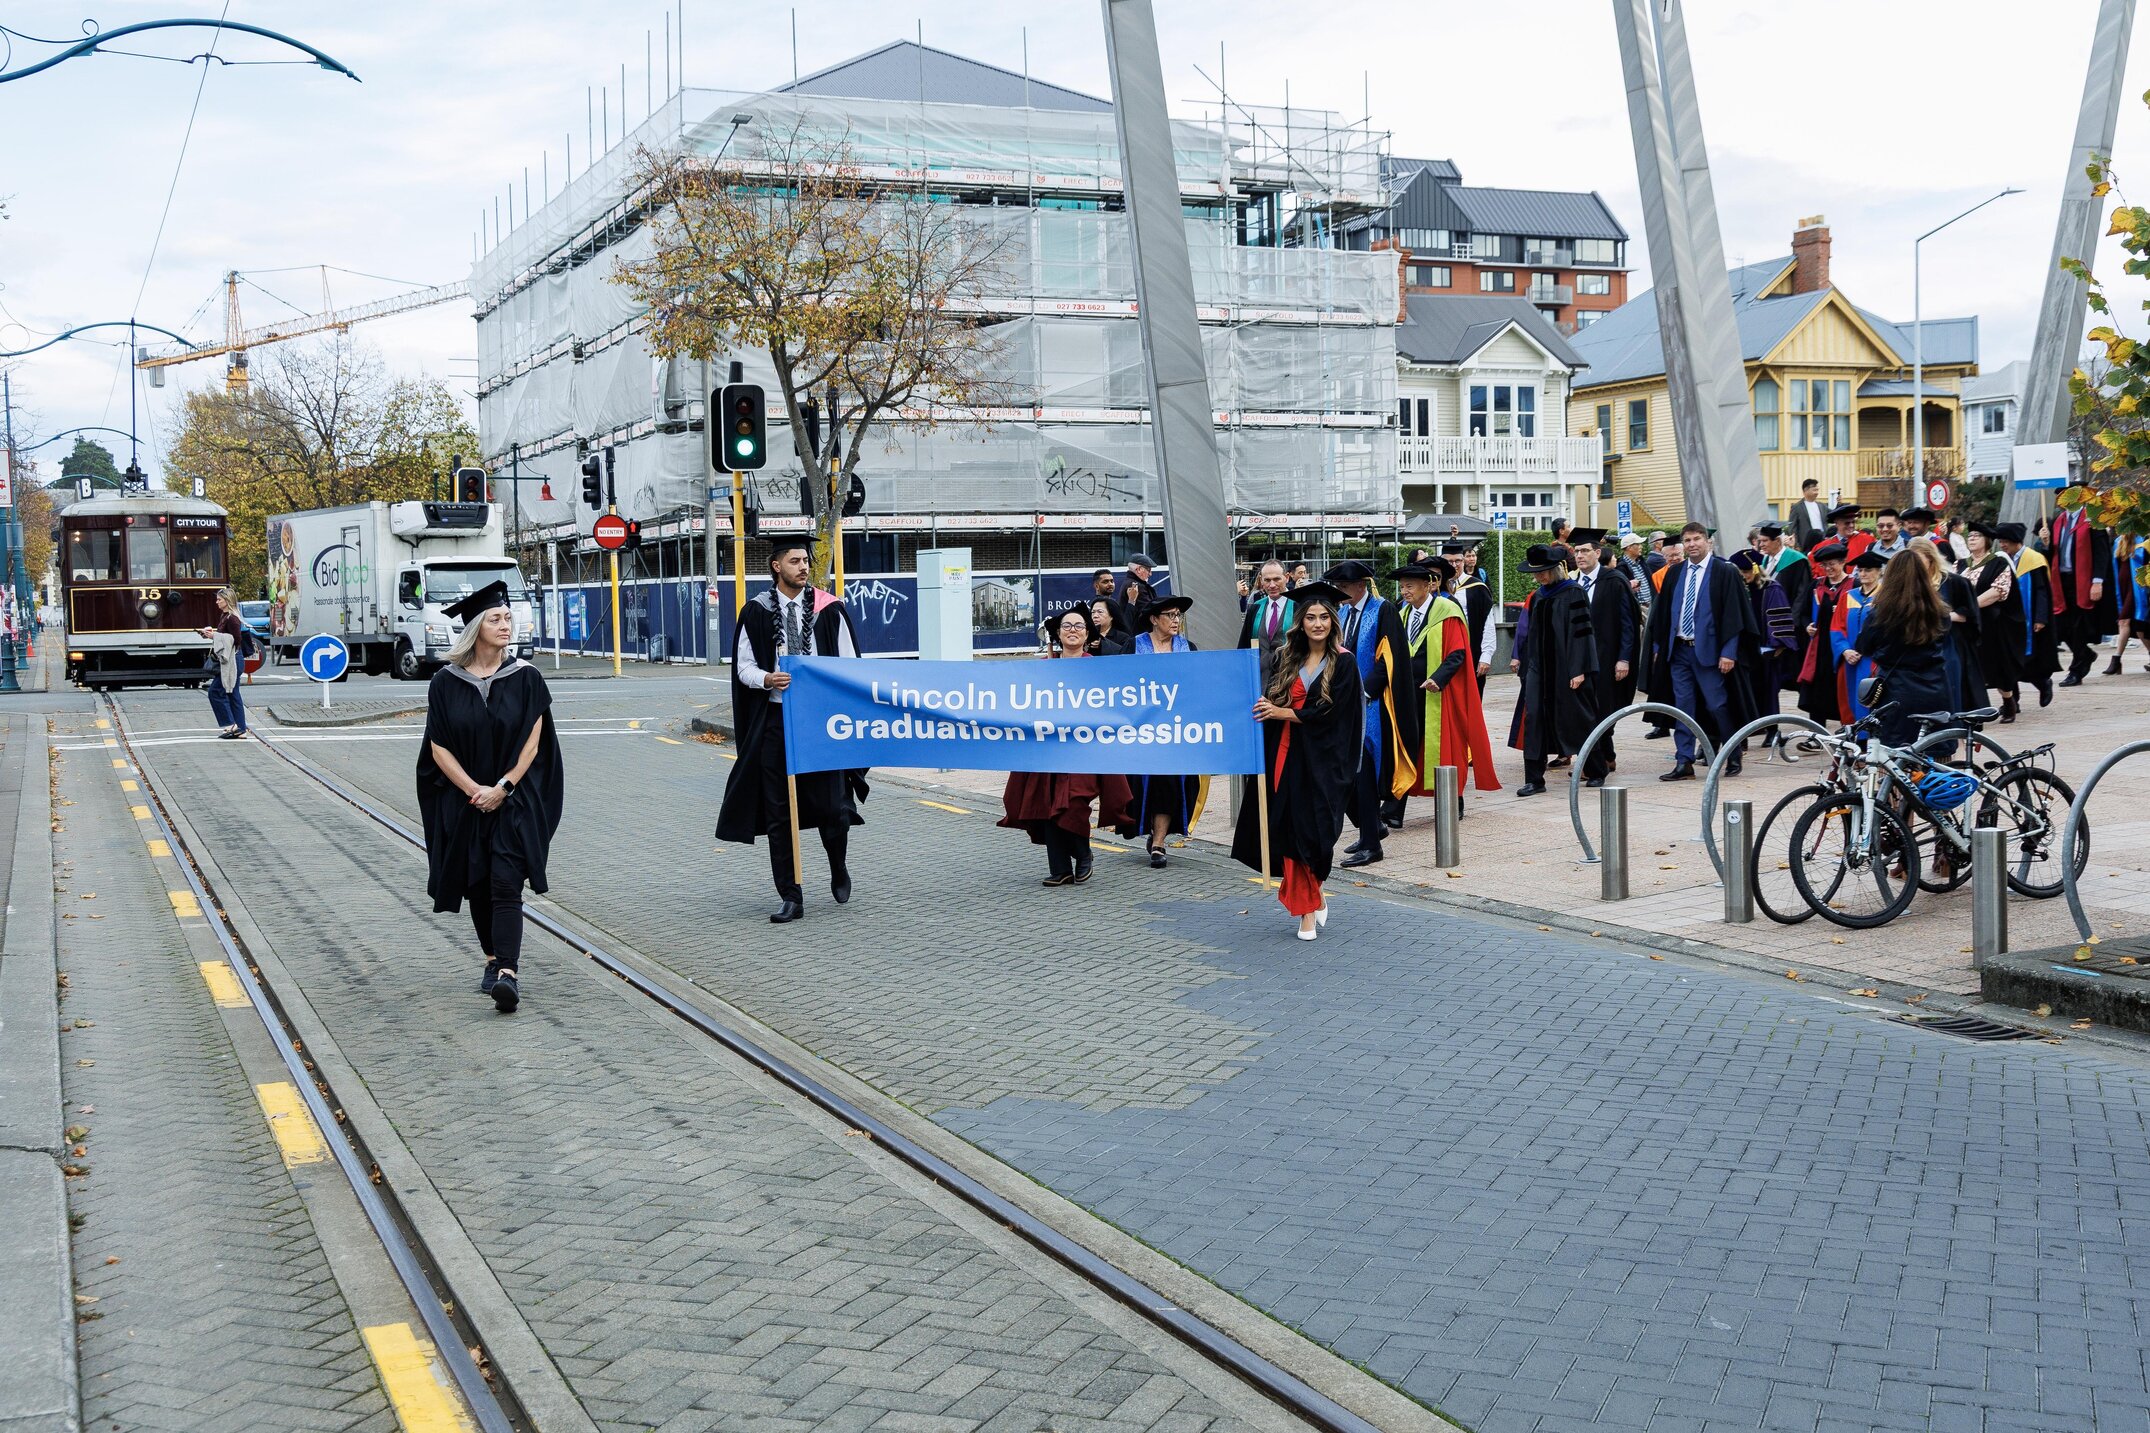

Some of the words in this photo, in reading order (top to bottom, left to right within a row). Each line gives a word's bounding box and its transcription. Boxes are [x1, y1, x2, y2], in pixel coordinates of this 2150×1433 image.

[1102, 179, 1122, 187] SCAF
[1255, 311, 1294, 320] SCAFFOLD
[1100, 411, 1141, 419] SCAFFOLD
[81, 478, 93, 498] B
[194, 477, 205, 498] B
[1932, 488, 1944, 501] 30
[176, 518, 195, 527] CITY
[196, 519, 218, 527] TOUR
[759, 519, 792, 527] AFFOLD
[321, 561, 369, 587] Bidfood
[138, 588, 162, 600] 15
[871, 679, 998, 712] Lincoln
[1009, 677, 1180, 711] University
[826, 713, 1026, 742] Graduation
[1035, 715, 1224, 745] Procession
